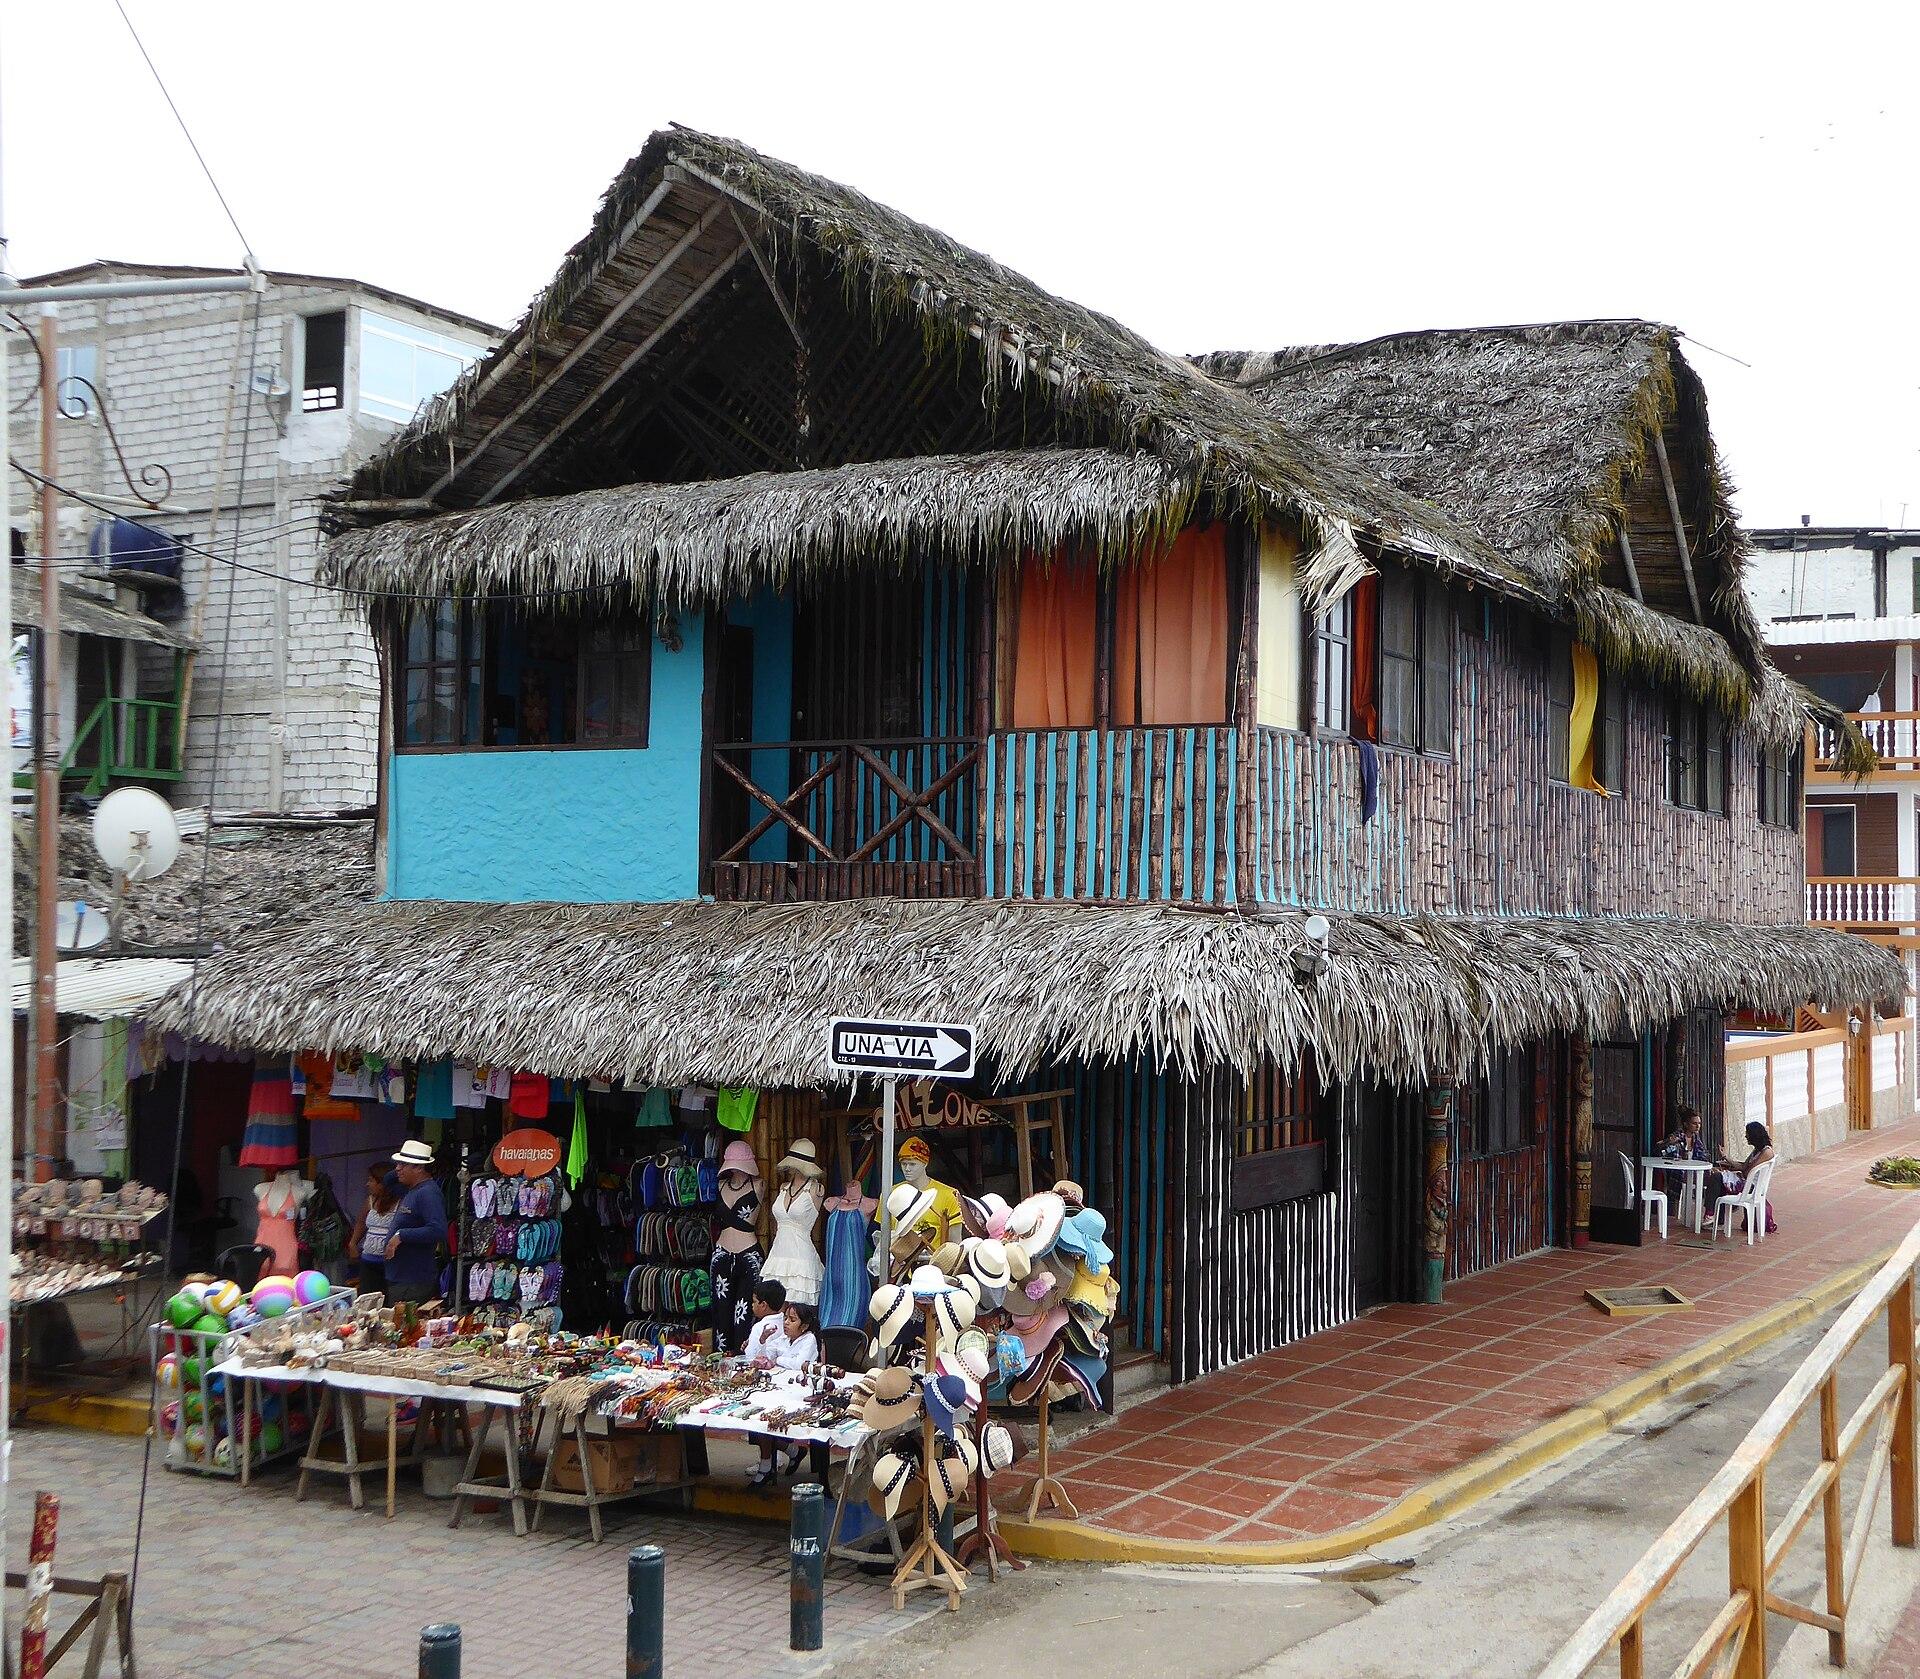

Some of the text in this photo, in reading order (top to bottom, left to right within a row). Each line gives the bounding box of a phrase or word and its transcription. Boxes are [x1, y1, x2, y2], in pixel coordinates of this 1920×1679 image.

[844, 1034, 935, 1058] UNA VIA
[499, 1146, 554, 1162] havaianas
